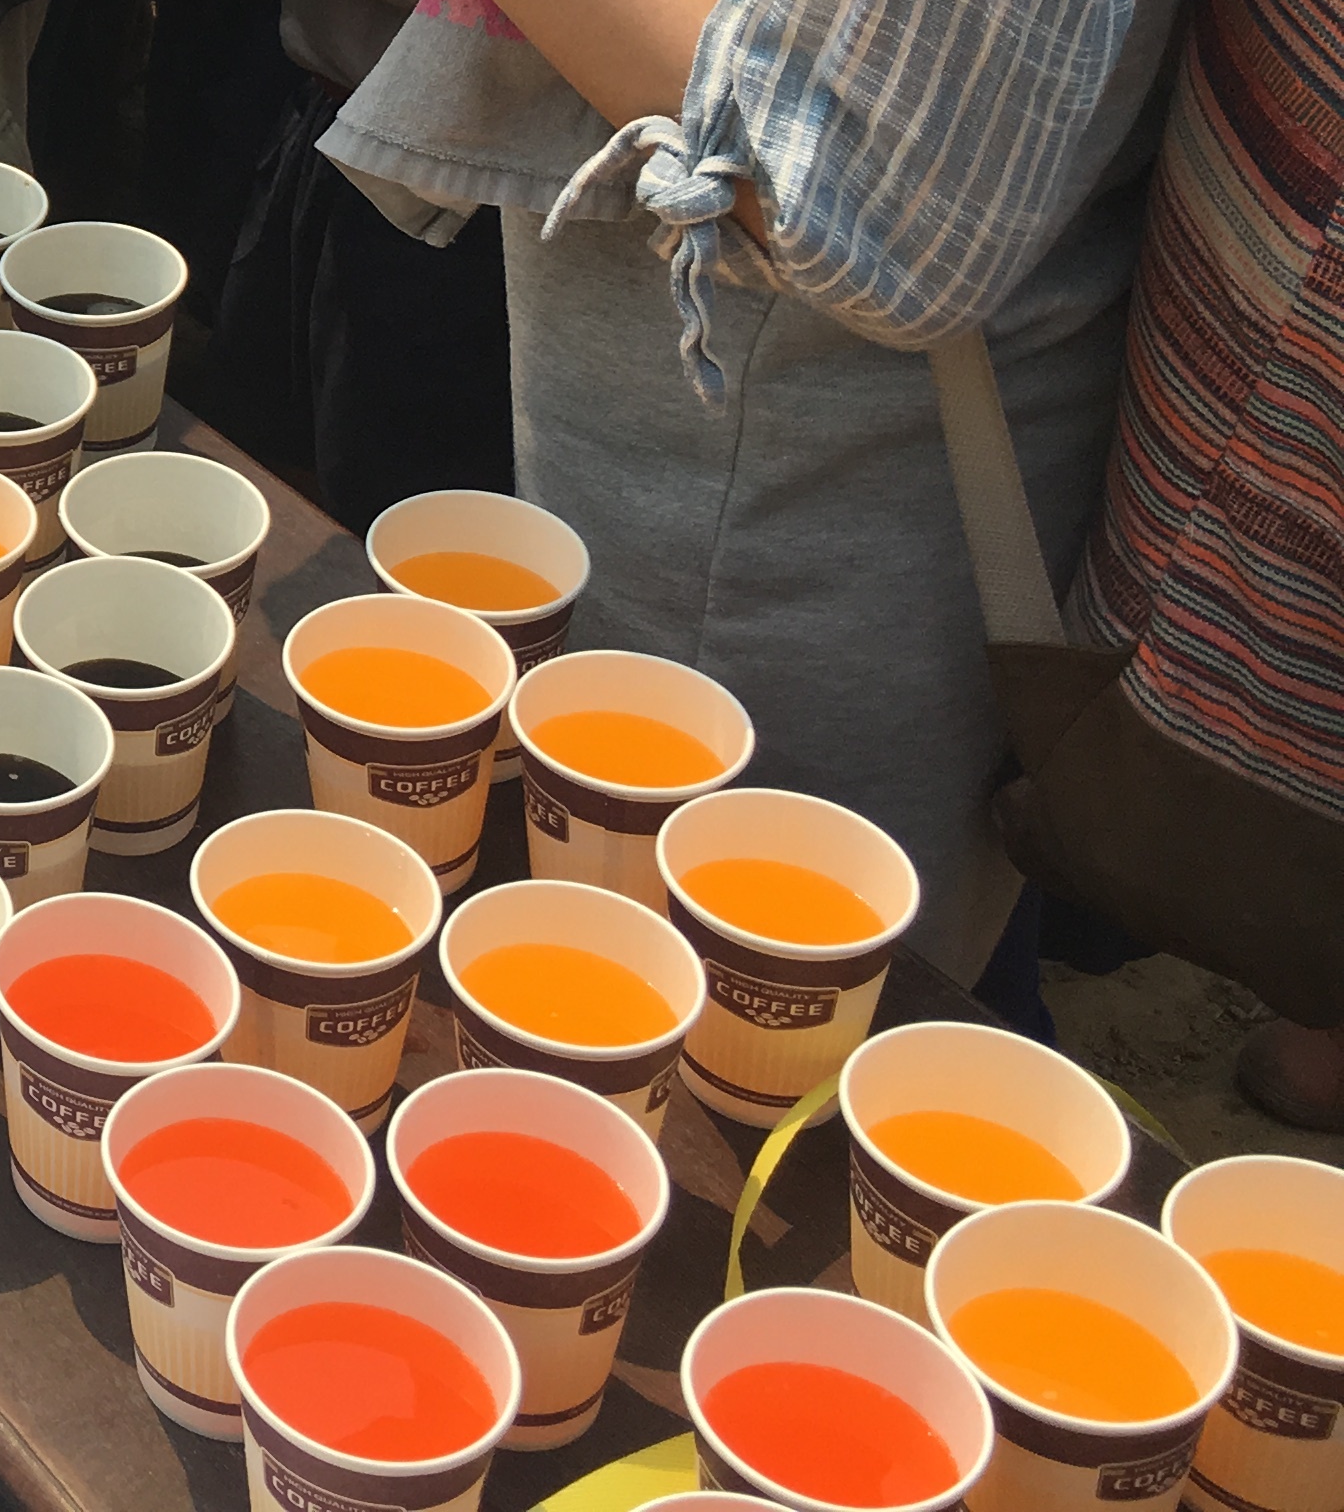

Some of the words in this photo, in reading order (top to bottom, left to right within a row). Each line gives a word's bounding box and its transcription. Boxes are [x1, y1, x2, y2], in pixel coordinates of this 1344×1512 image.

[380, 769, 471, 793] COFFEE
[716, 980, 824, 1017] COFFEE
[730, 976, 759, 992] HIGH
[761, 987, 811, 1001] QUALITY
[39, 1081, 64, 1100] HIGH
[28, 1084, 106, 1129] COFFE
